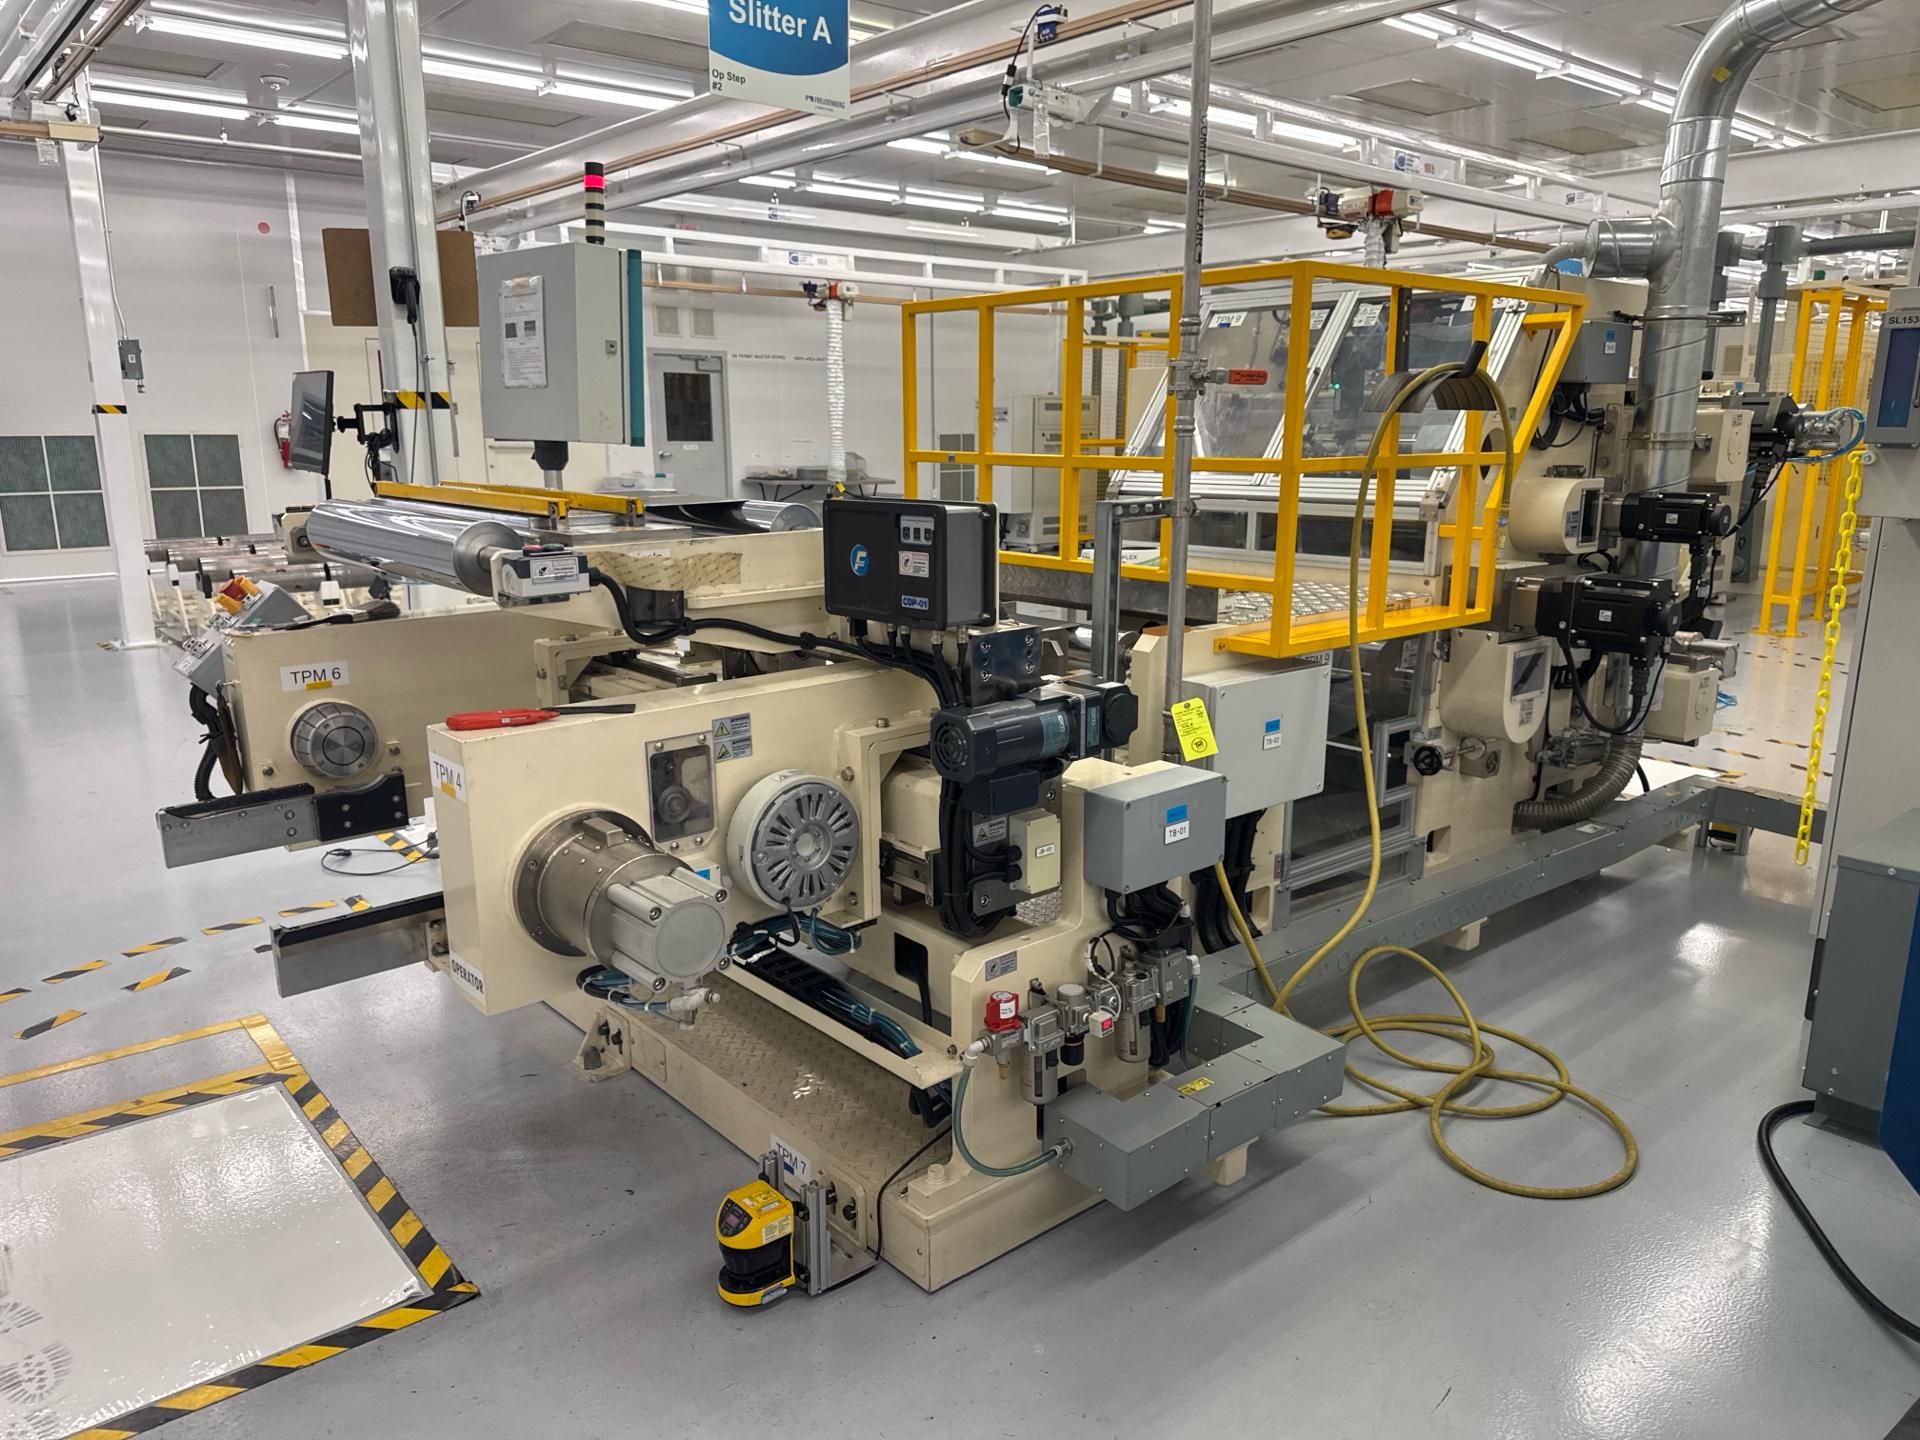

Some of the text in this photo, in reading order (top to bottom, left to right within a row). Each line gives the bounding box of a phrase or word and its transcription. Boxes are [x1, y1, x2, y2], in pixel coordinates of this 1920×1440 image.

[729, 0, 832, 45] Slitter A
[711, 81, 723, 91] #2
[712, 68, 746, 85] Op Step
[1195, 221, 1204, 247] AIR
[902, 596, 928, 609] CDP-01
[290, 667, 341, 685] TPM 6
[433, 761, 462, 791] TPM 4
[1169, 826, 1186, 838] TB-01
[451, 959, 484, 994] OPERATOR
[775, 1142, 807, 1175] TPM 7
